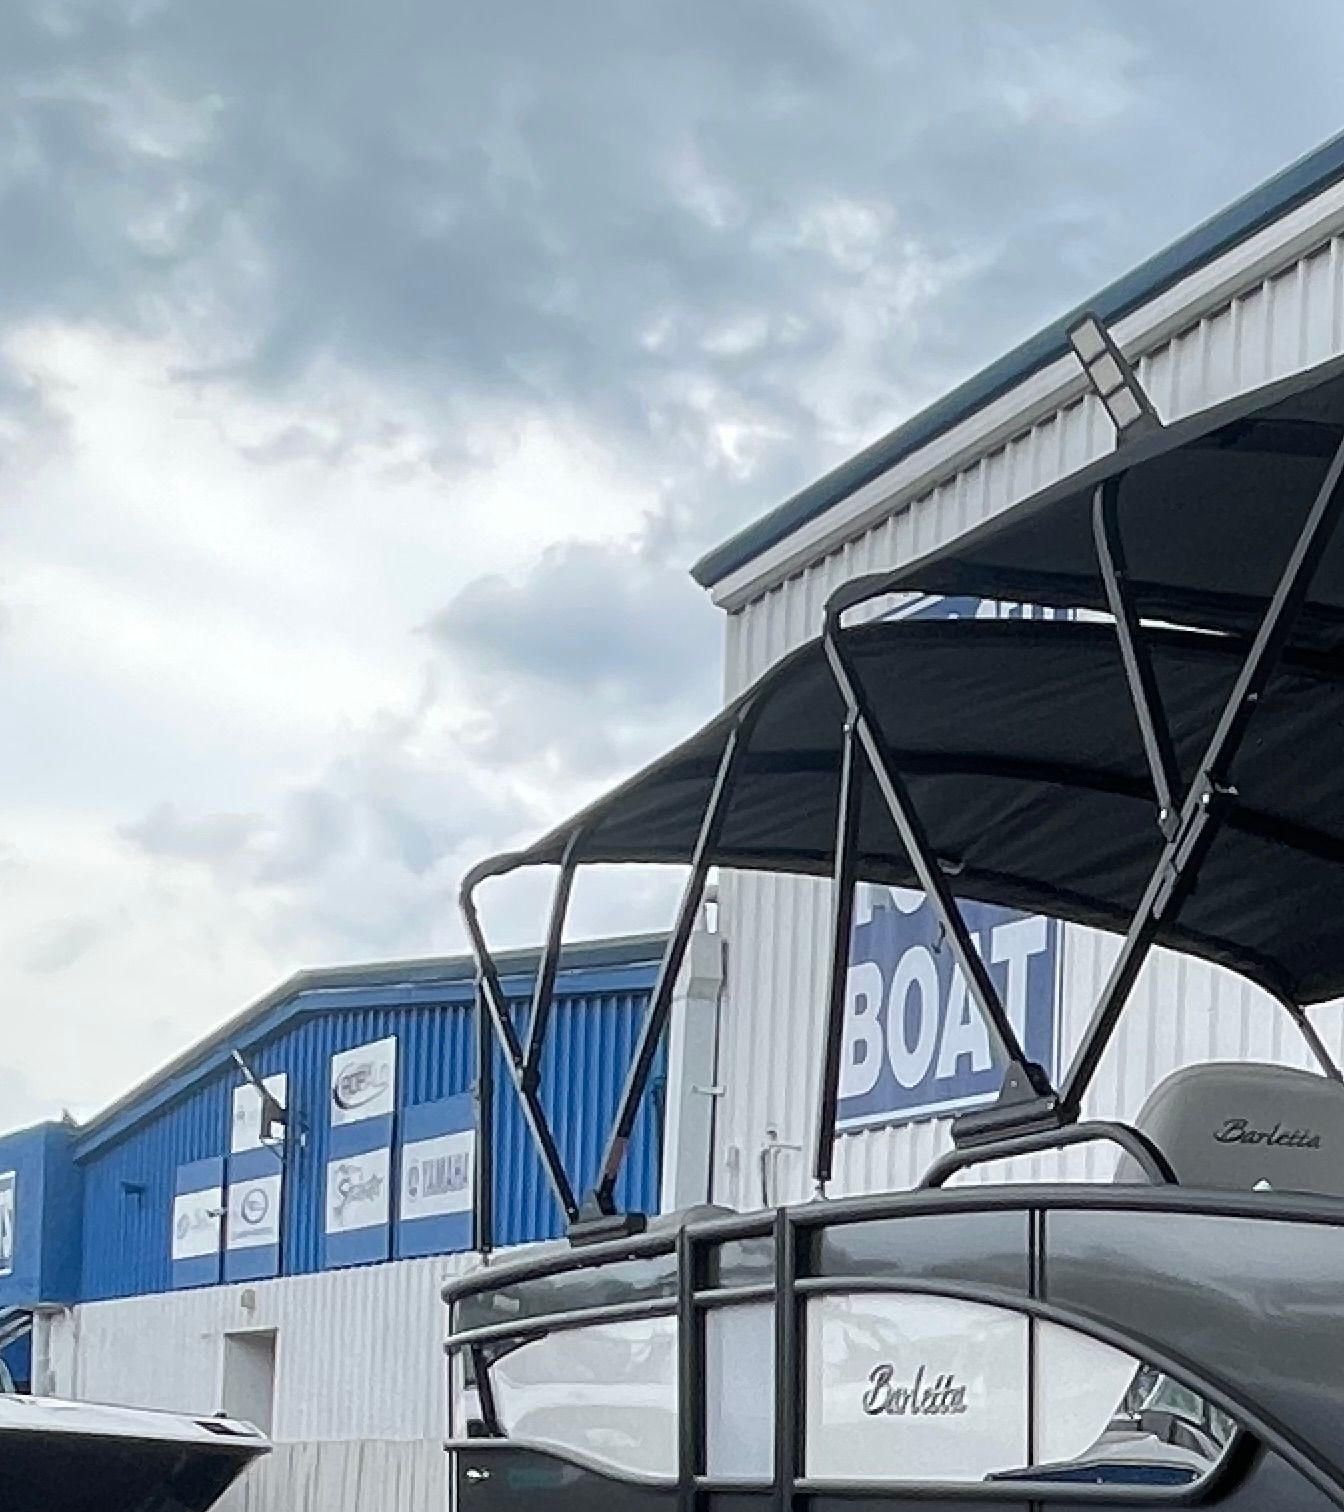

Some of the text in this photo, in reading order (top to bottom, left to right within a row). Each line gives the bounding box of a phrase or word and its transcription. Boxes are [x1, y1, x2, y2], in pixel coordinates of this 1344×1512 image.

[838, 915, 1047, 1099] BOAT
[1213, 1119, 1321, 1150] Barletta
[863, 1364, 967, 1415] Barletta
